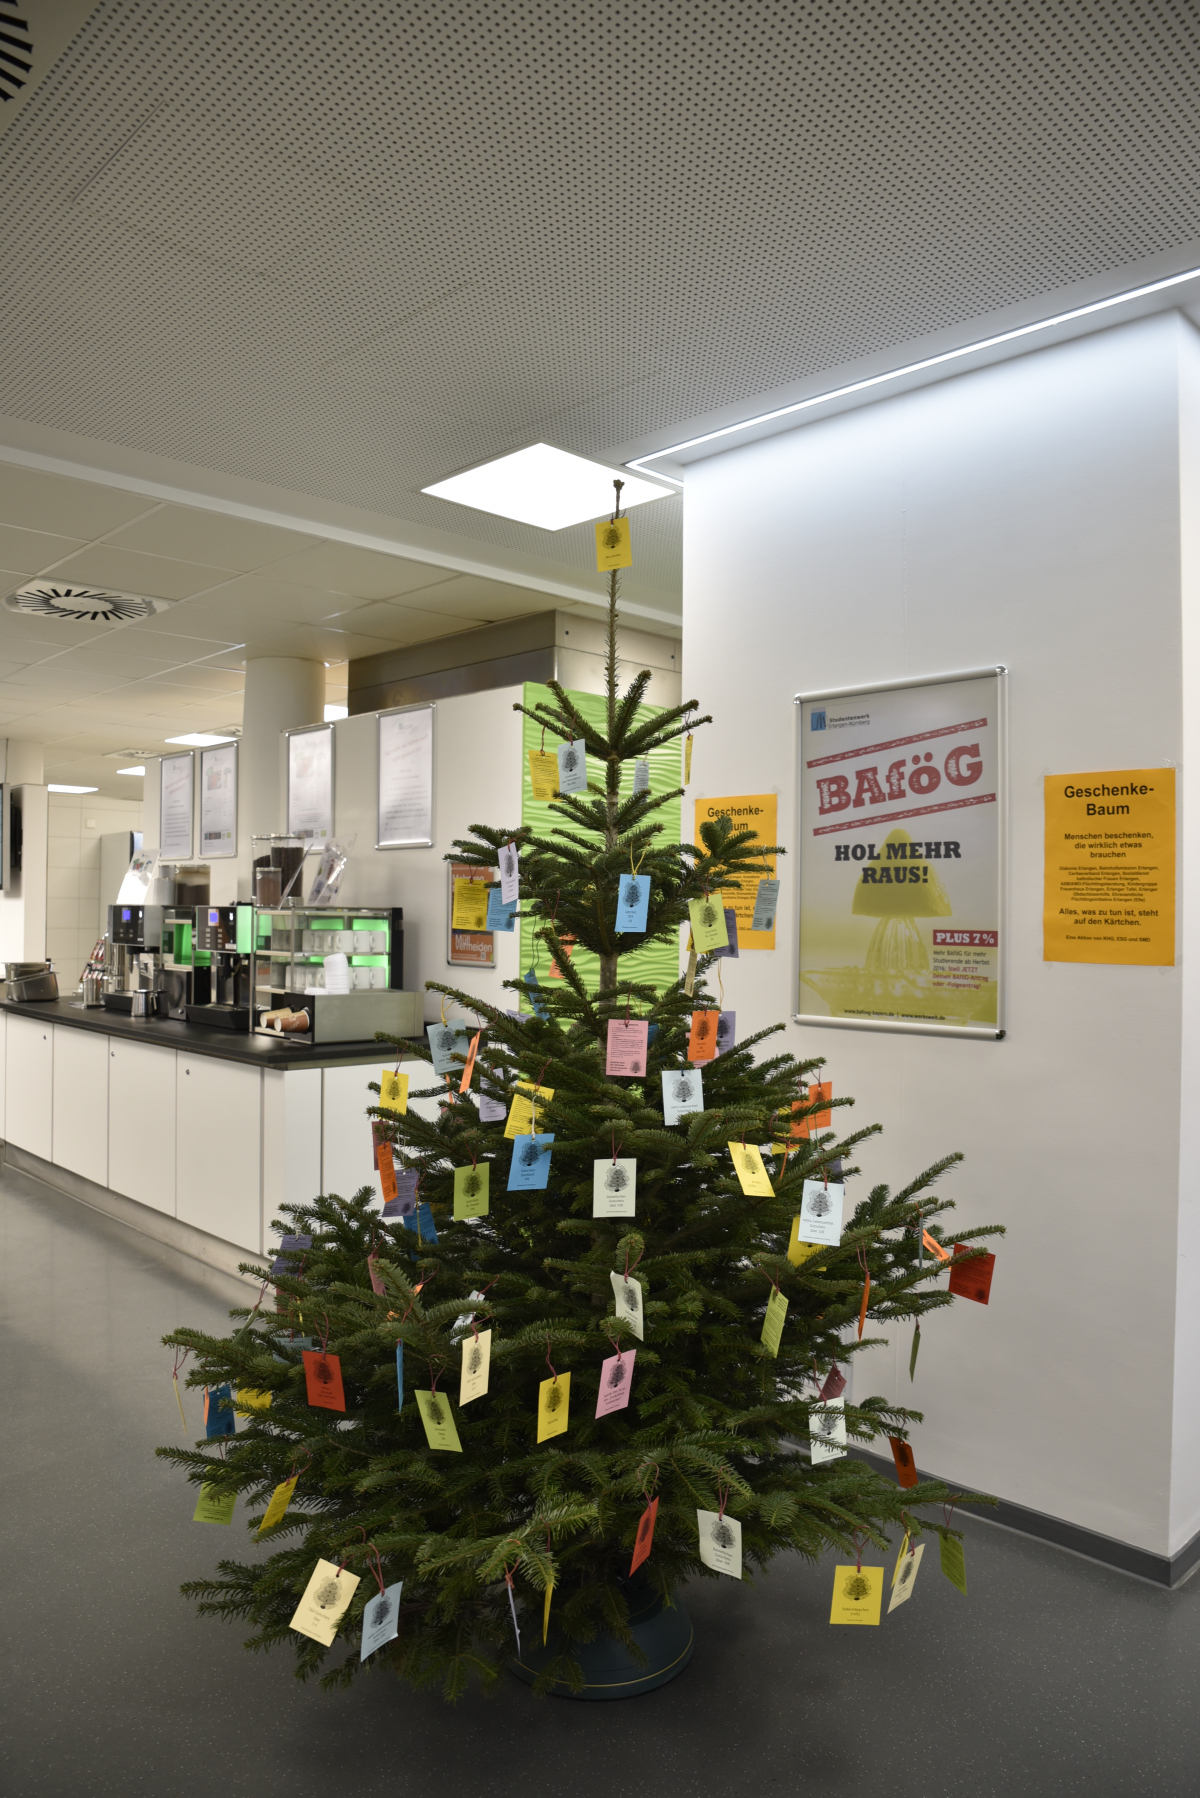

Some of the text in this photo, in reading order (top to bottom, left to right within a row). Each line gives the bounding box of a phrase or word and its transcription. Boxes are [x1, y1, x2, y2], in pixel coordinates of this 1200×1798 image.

[828, 720, 870, 728] Erlangen-Nürnberg
[830, 714, 870, 722] Studentenwerk
[816, 743, 983, 816] BAföG
[1064, 782, 1154, 798] Geschenke-
[708, 805, 764, 818] Geschenke-
[1086, 804, 1130, 816] Baum
[835, 841, 962, 861] HOL MEHR
[862, 866, 928, 884] RAUS!
[936, 932, 970, 943] PLUS
